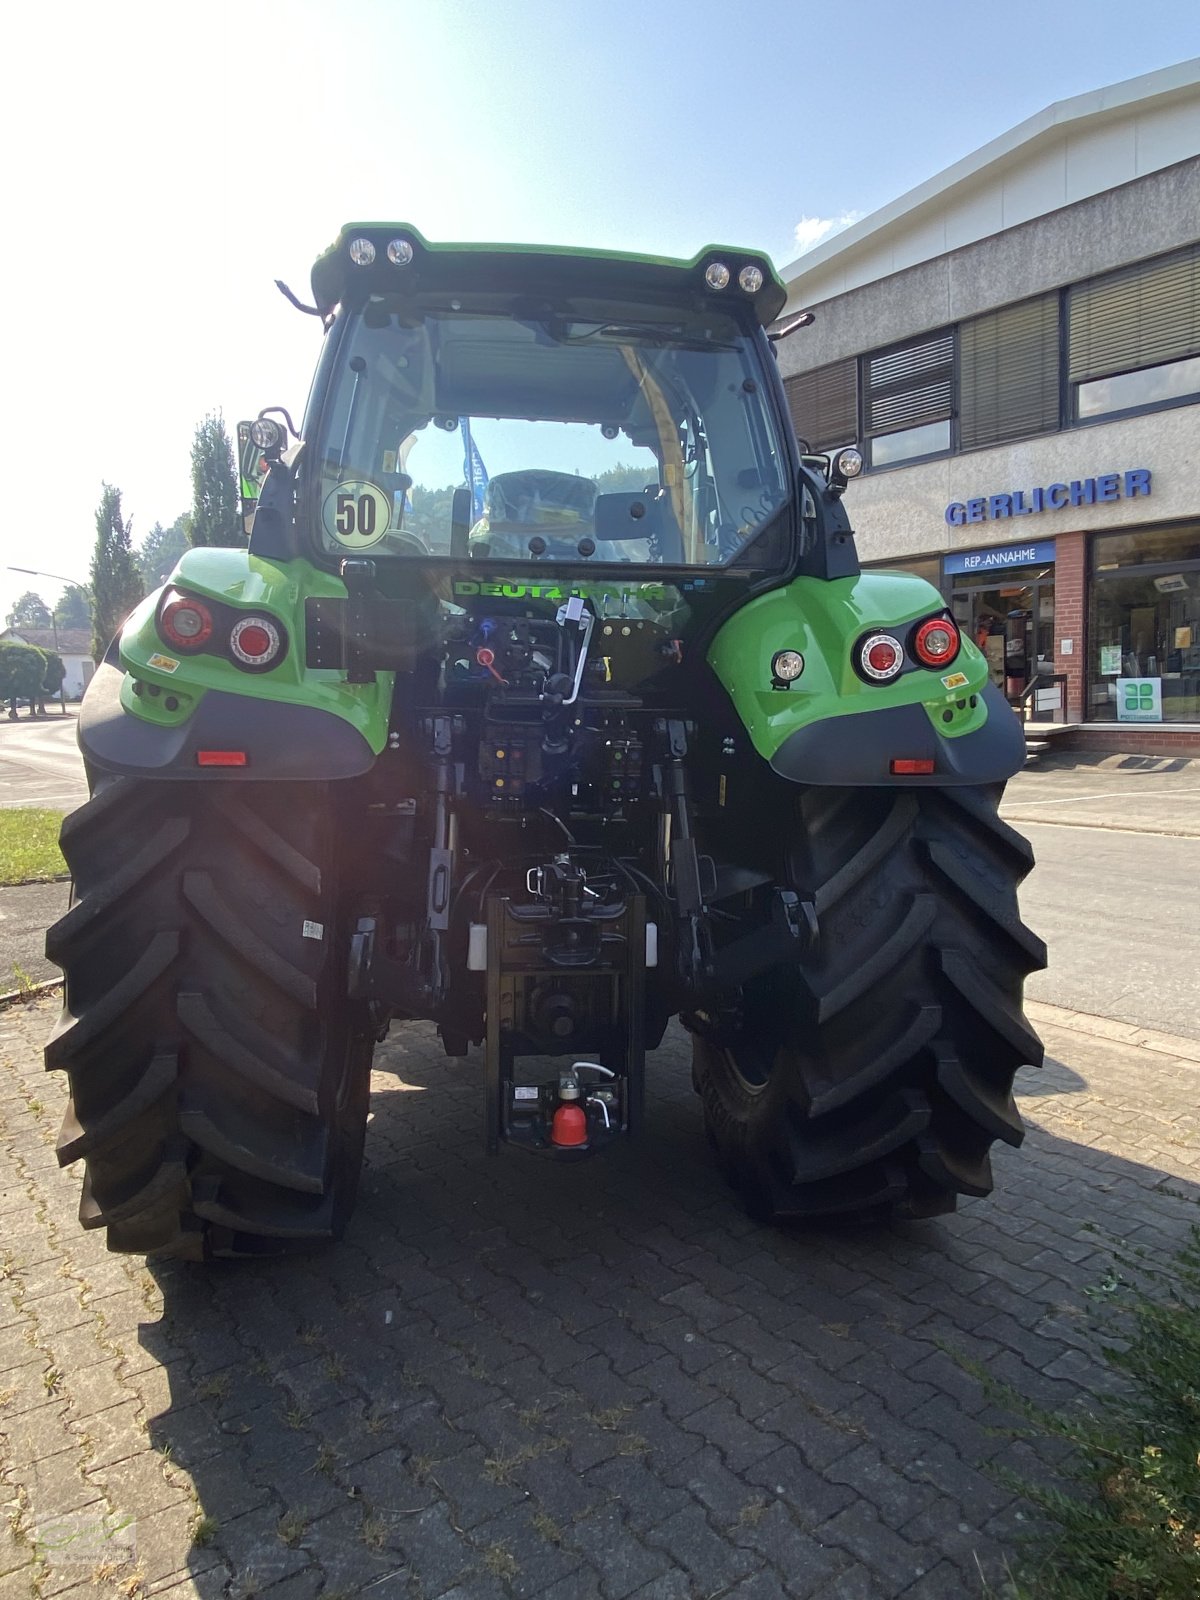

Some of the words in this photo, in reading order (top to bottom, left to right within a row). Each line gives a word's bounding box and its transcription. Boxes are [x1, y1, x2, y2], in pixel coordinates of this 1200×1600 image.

[336, 493, 376, 536] 50
[945, 468, 1152, 527] GERLICHER
[964, 548, 1036, 569] REP.-ANNAHME
